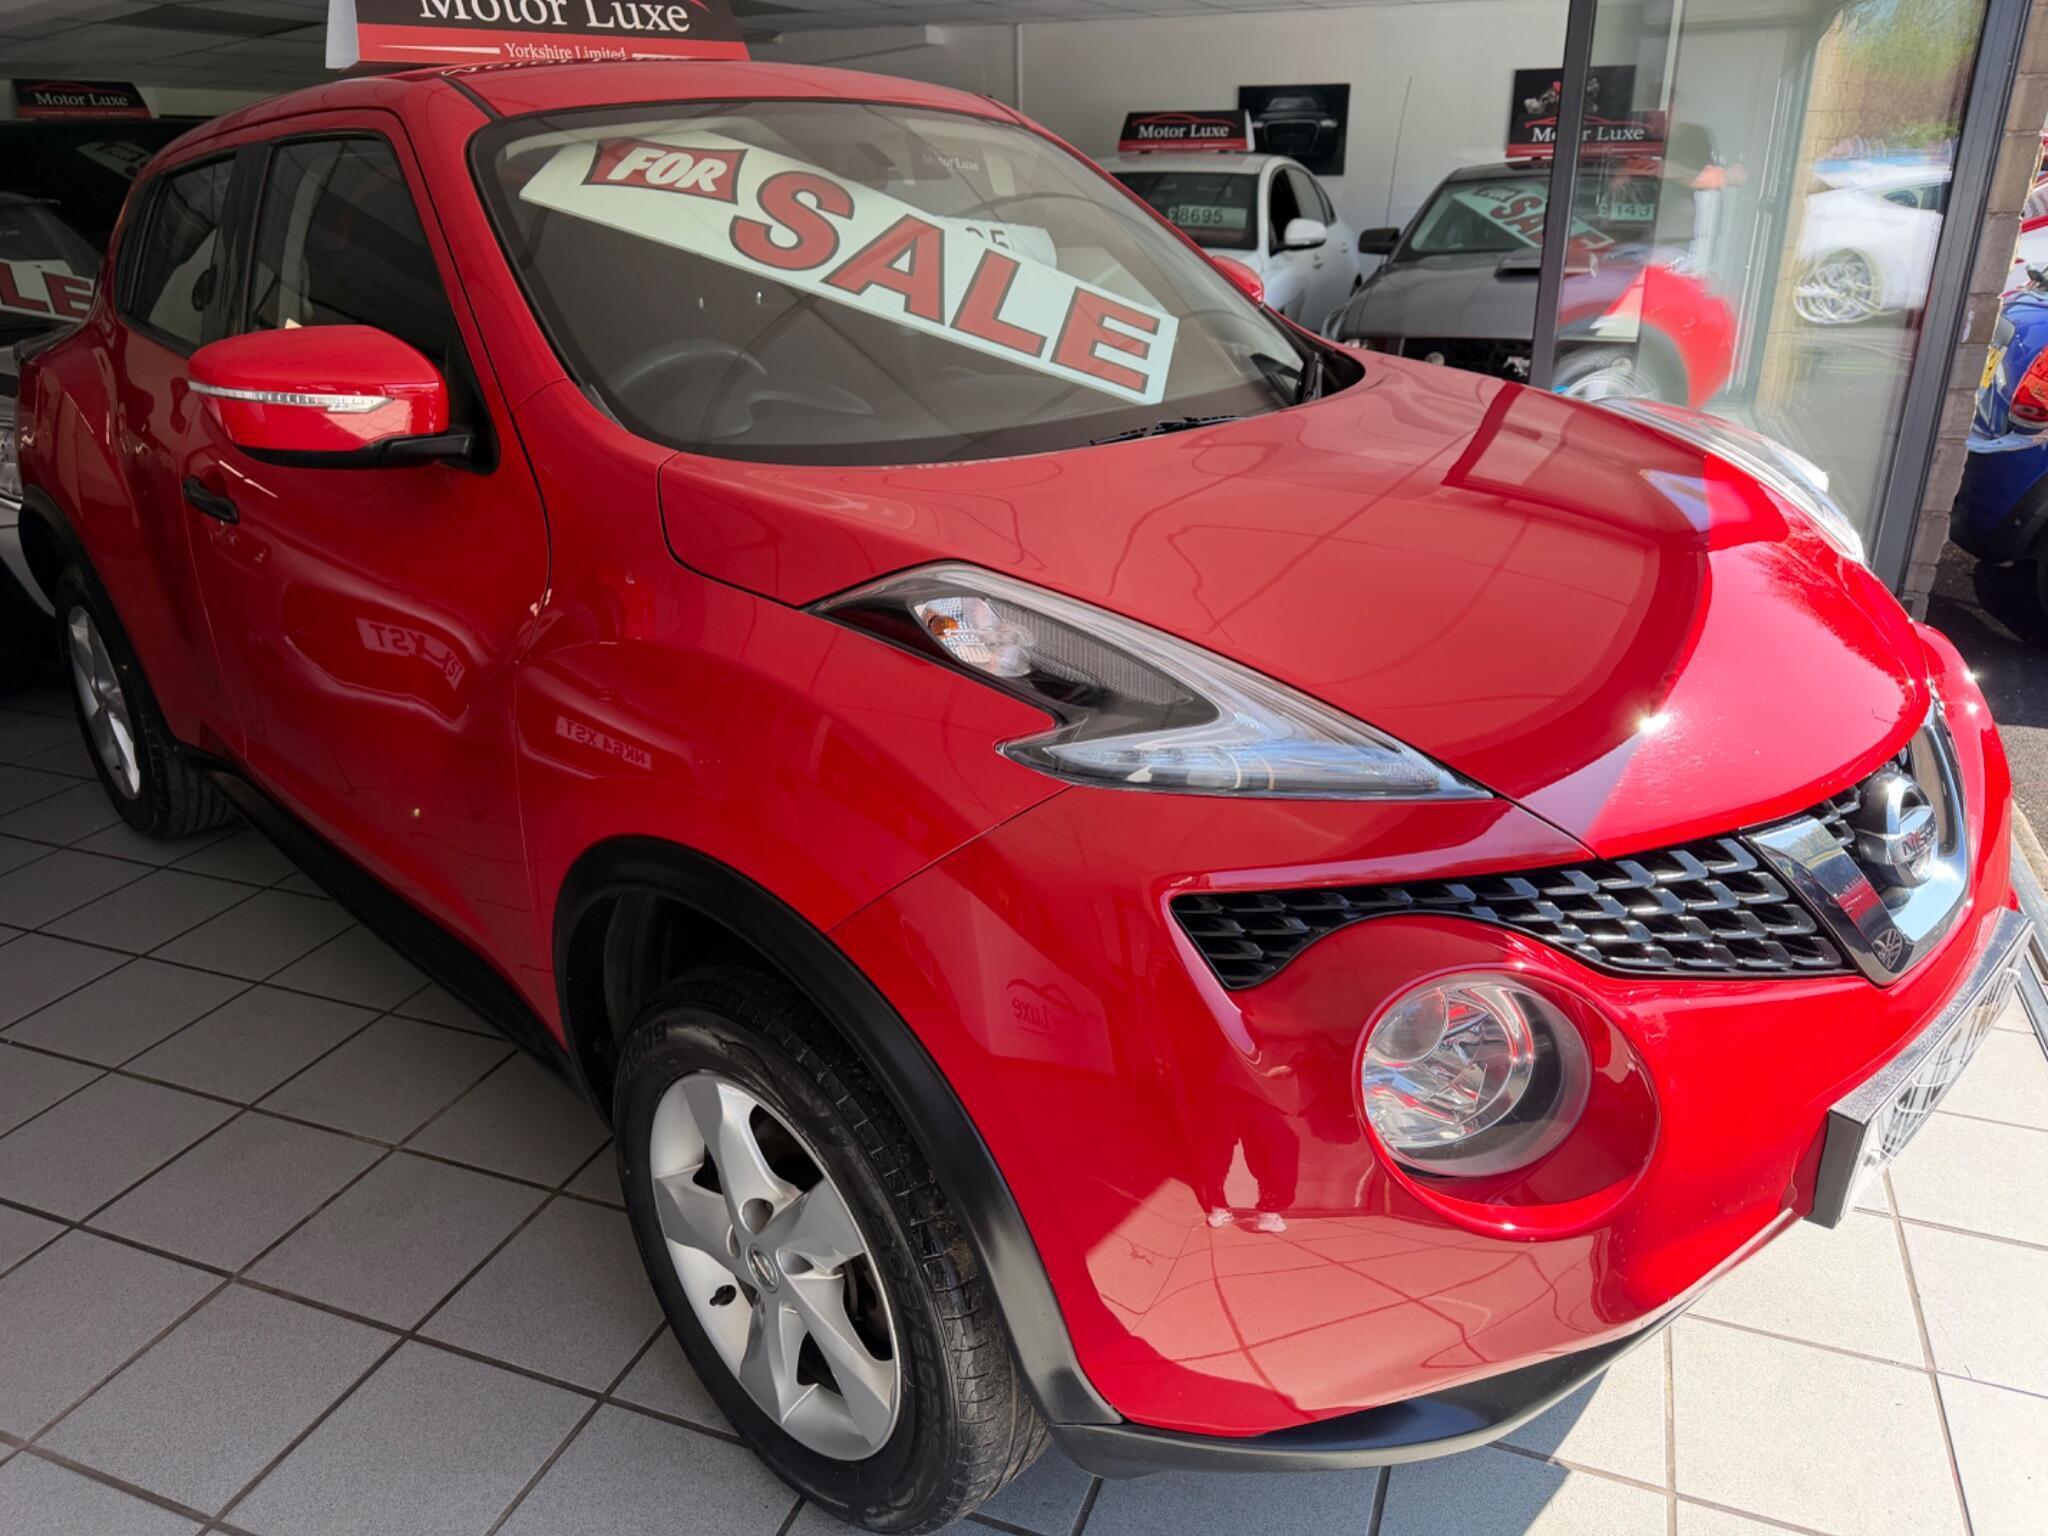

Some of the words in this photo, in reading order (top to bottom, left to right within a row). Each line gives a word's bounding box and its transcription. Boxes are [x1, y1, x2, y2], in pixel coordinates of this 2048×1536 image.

[586, 0, 691, 32] Luxe
[503, 42, 573, 60] Yorkshire
[35, 93, 86, 106] Motor
[89, 93, 129, 107] Luxe
[1138, 125, 1186, 139] Motor
[1189, 124, 1230, 138] Luxe
[1596, 126, 1646, 141] Luxe
[606, 146, 729, 193] FOR
[729, 170, 1161, 394] SALE
